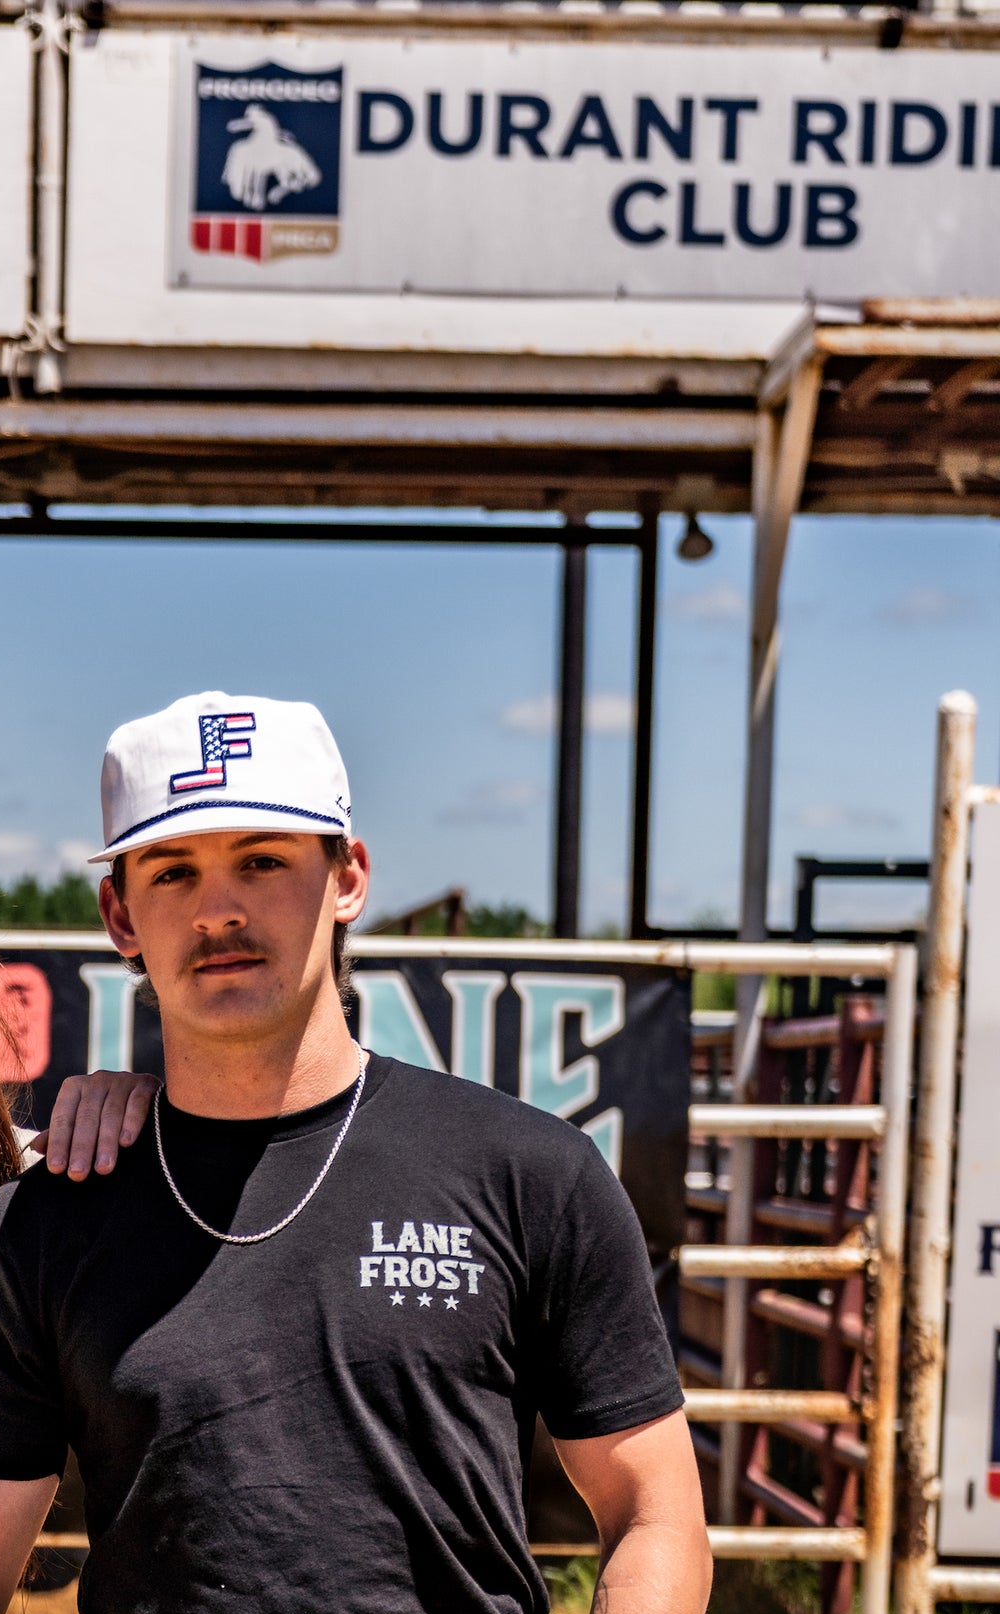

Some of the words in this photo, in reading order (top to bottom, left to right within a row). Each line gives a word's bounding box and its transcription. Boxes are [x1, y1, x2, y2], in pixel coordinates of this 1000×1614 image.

[198, 78, 341, 102] PRORODEO
[355, 90, 760, 163] DURANT
[791, 100, 1000, 168] RIDI
[611, 178, 861, 250] CLUB
[371, 1221, 473, 1259] LANE
[359, 1255, 486, 1295] FROST
